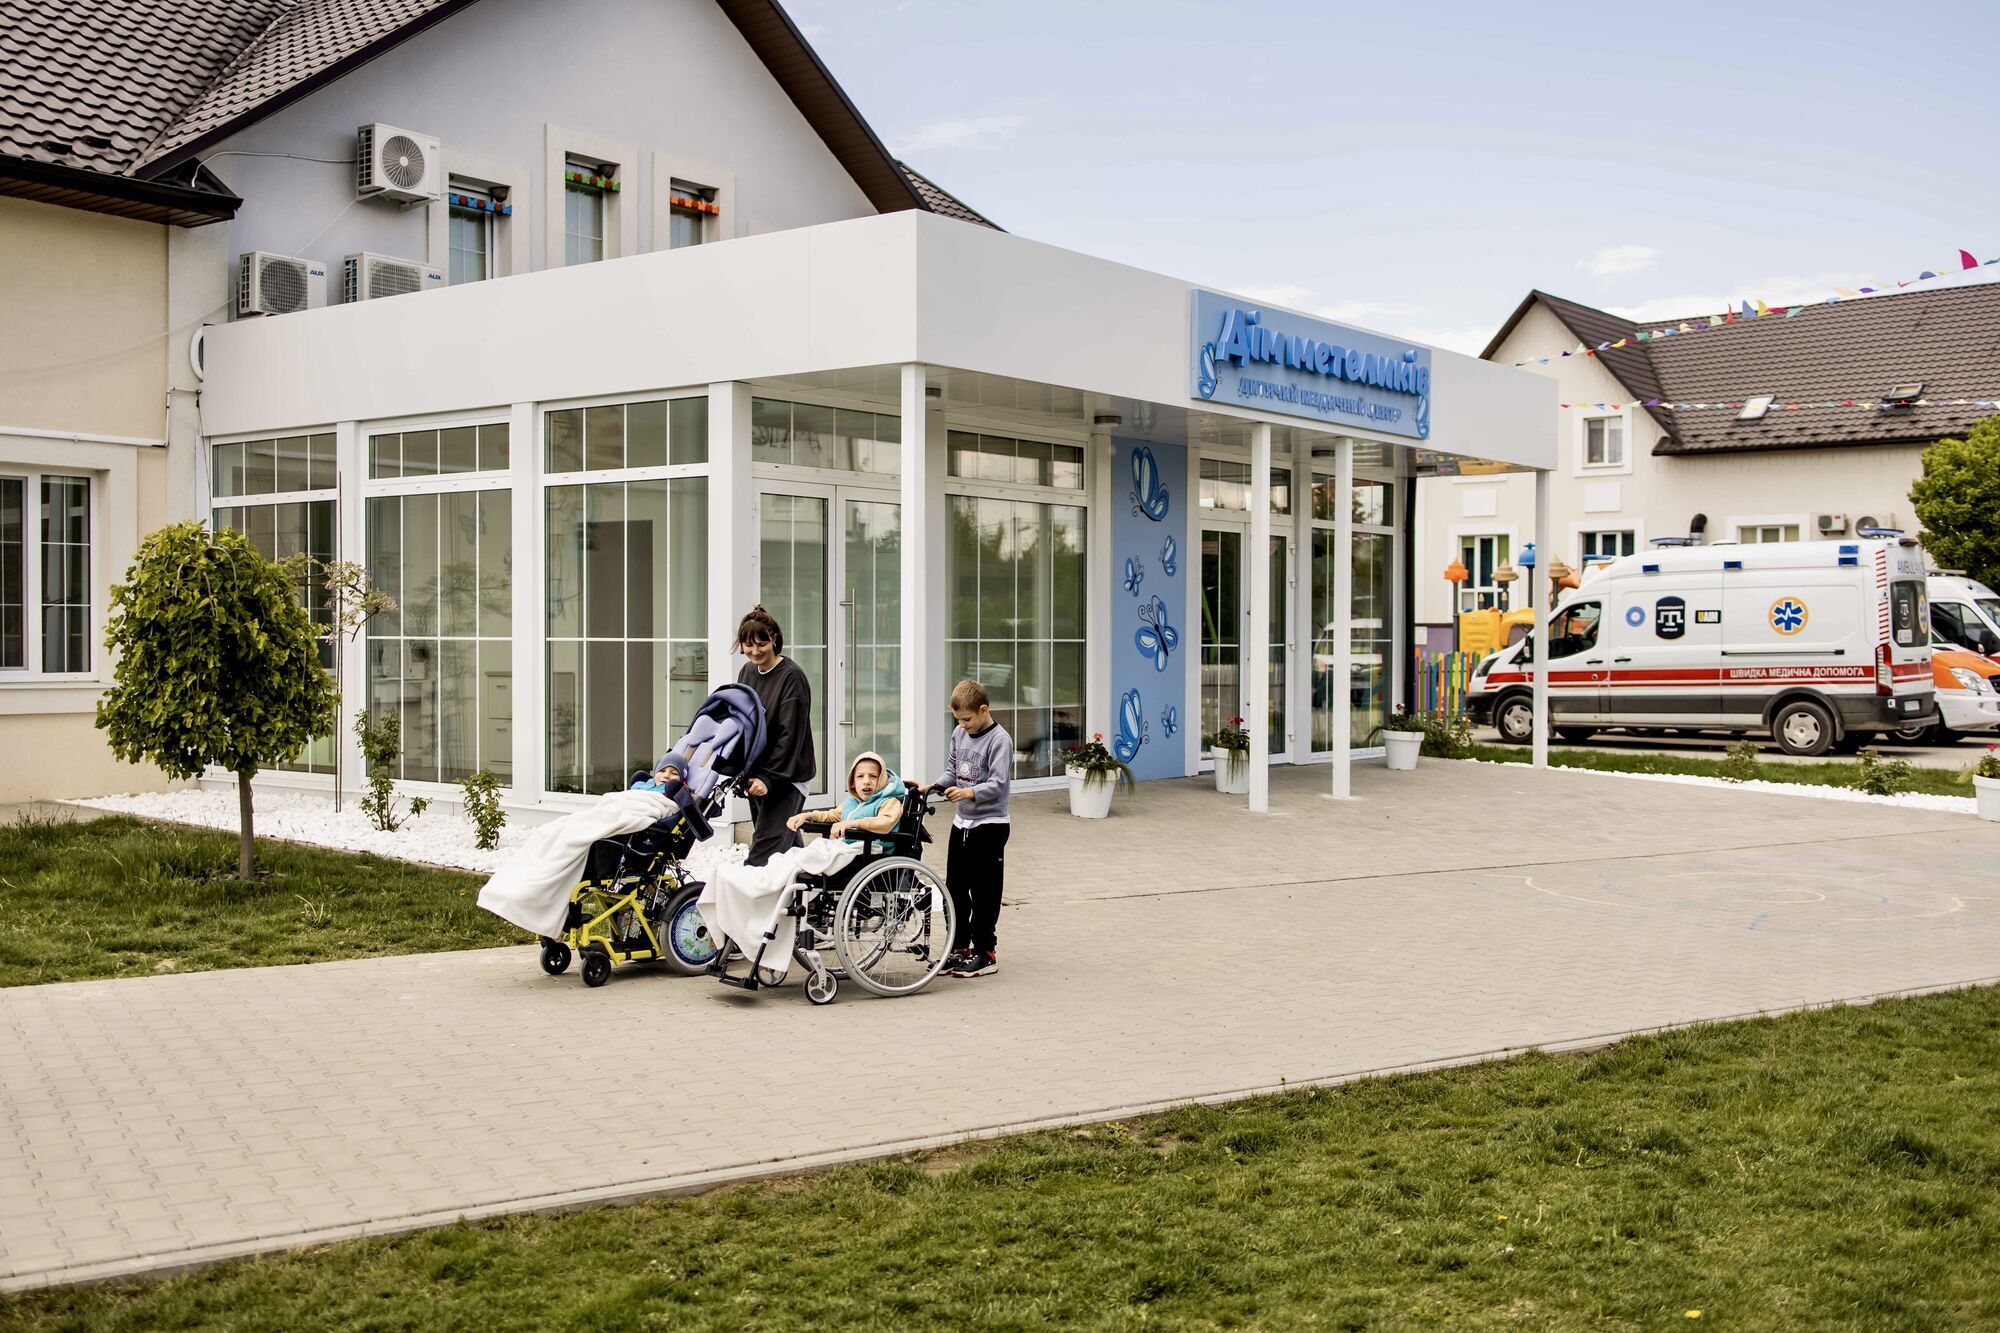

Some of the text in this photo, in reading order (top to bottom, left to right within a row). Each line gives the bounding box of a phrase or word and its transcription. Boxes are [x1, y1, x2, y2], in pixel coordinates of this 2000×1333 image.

[1215, 309, 1430, 396] Дім метеликів
[1729, 666, 1865, 679] ШВИДКА МЕДИЧНА ДОПОМОГА
